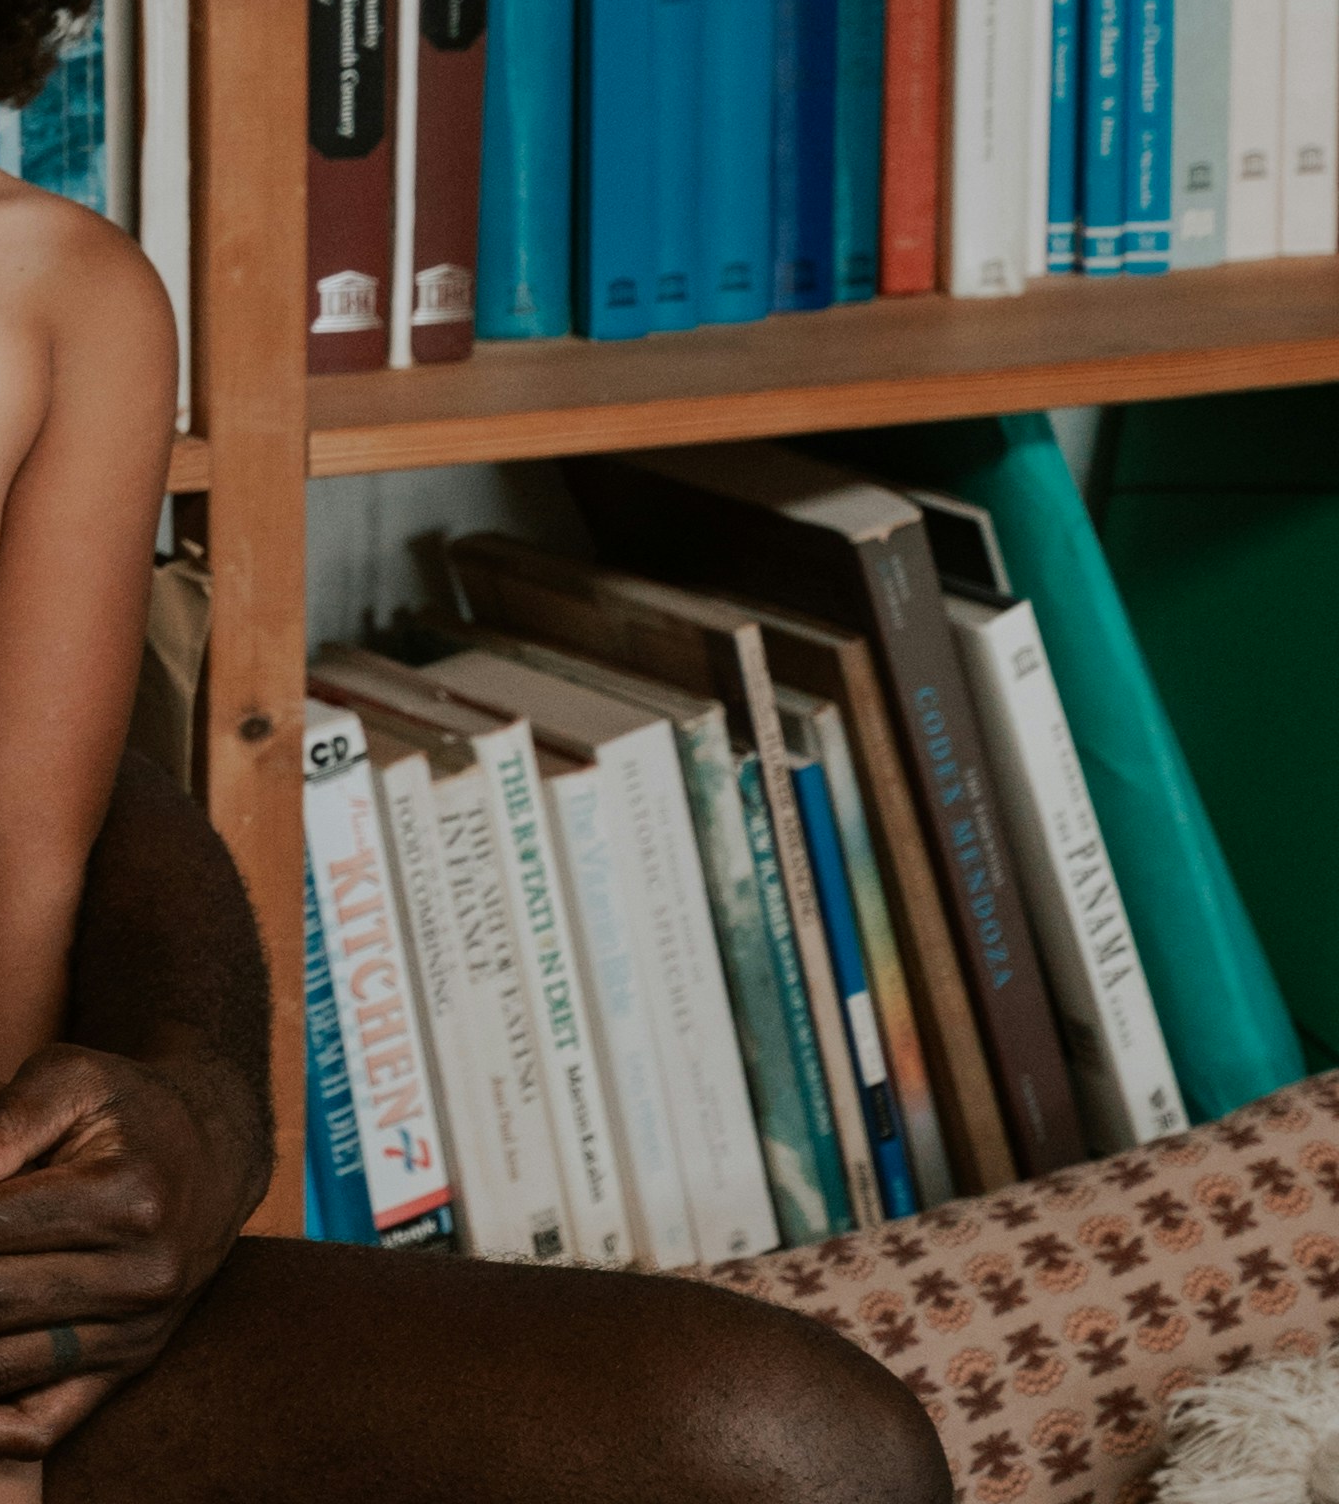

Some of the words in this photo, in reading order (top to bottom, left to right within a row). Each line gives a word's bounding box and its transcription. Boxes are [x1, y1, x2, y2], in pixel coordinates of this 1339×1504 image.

[395, 794, 422, 861] FOOD
[409, 869, 453, 1018] COMBINING
[446, 855, 493, 984] FRANCE
[465, 798, 496, 867] THE
[501, 986, 538, 1105] EATING
[497, 753, 531, 819] THE
[541, 978, 580, 1052] DIET
[913, 685, 964, 809] CODEX
[951, 817, 1013, 992] MENDOZA
[1063, 837, 1136, 996] PANAMA
[326, 845, 425, 1130] KITCHEN
